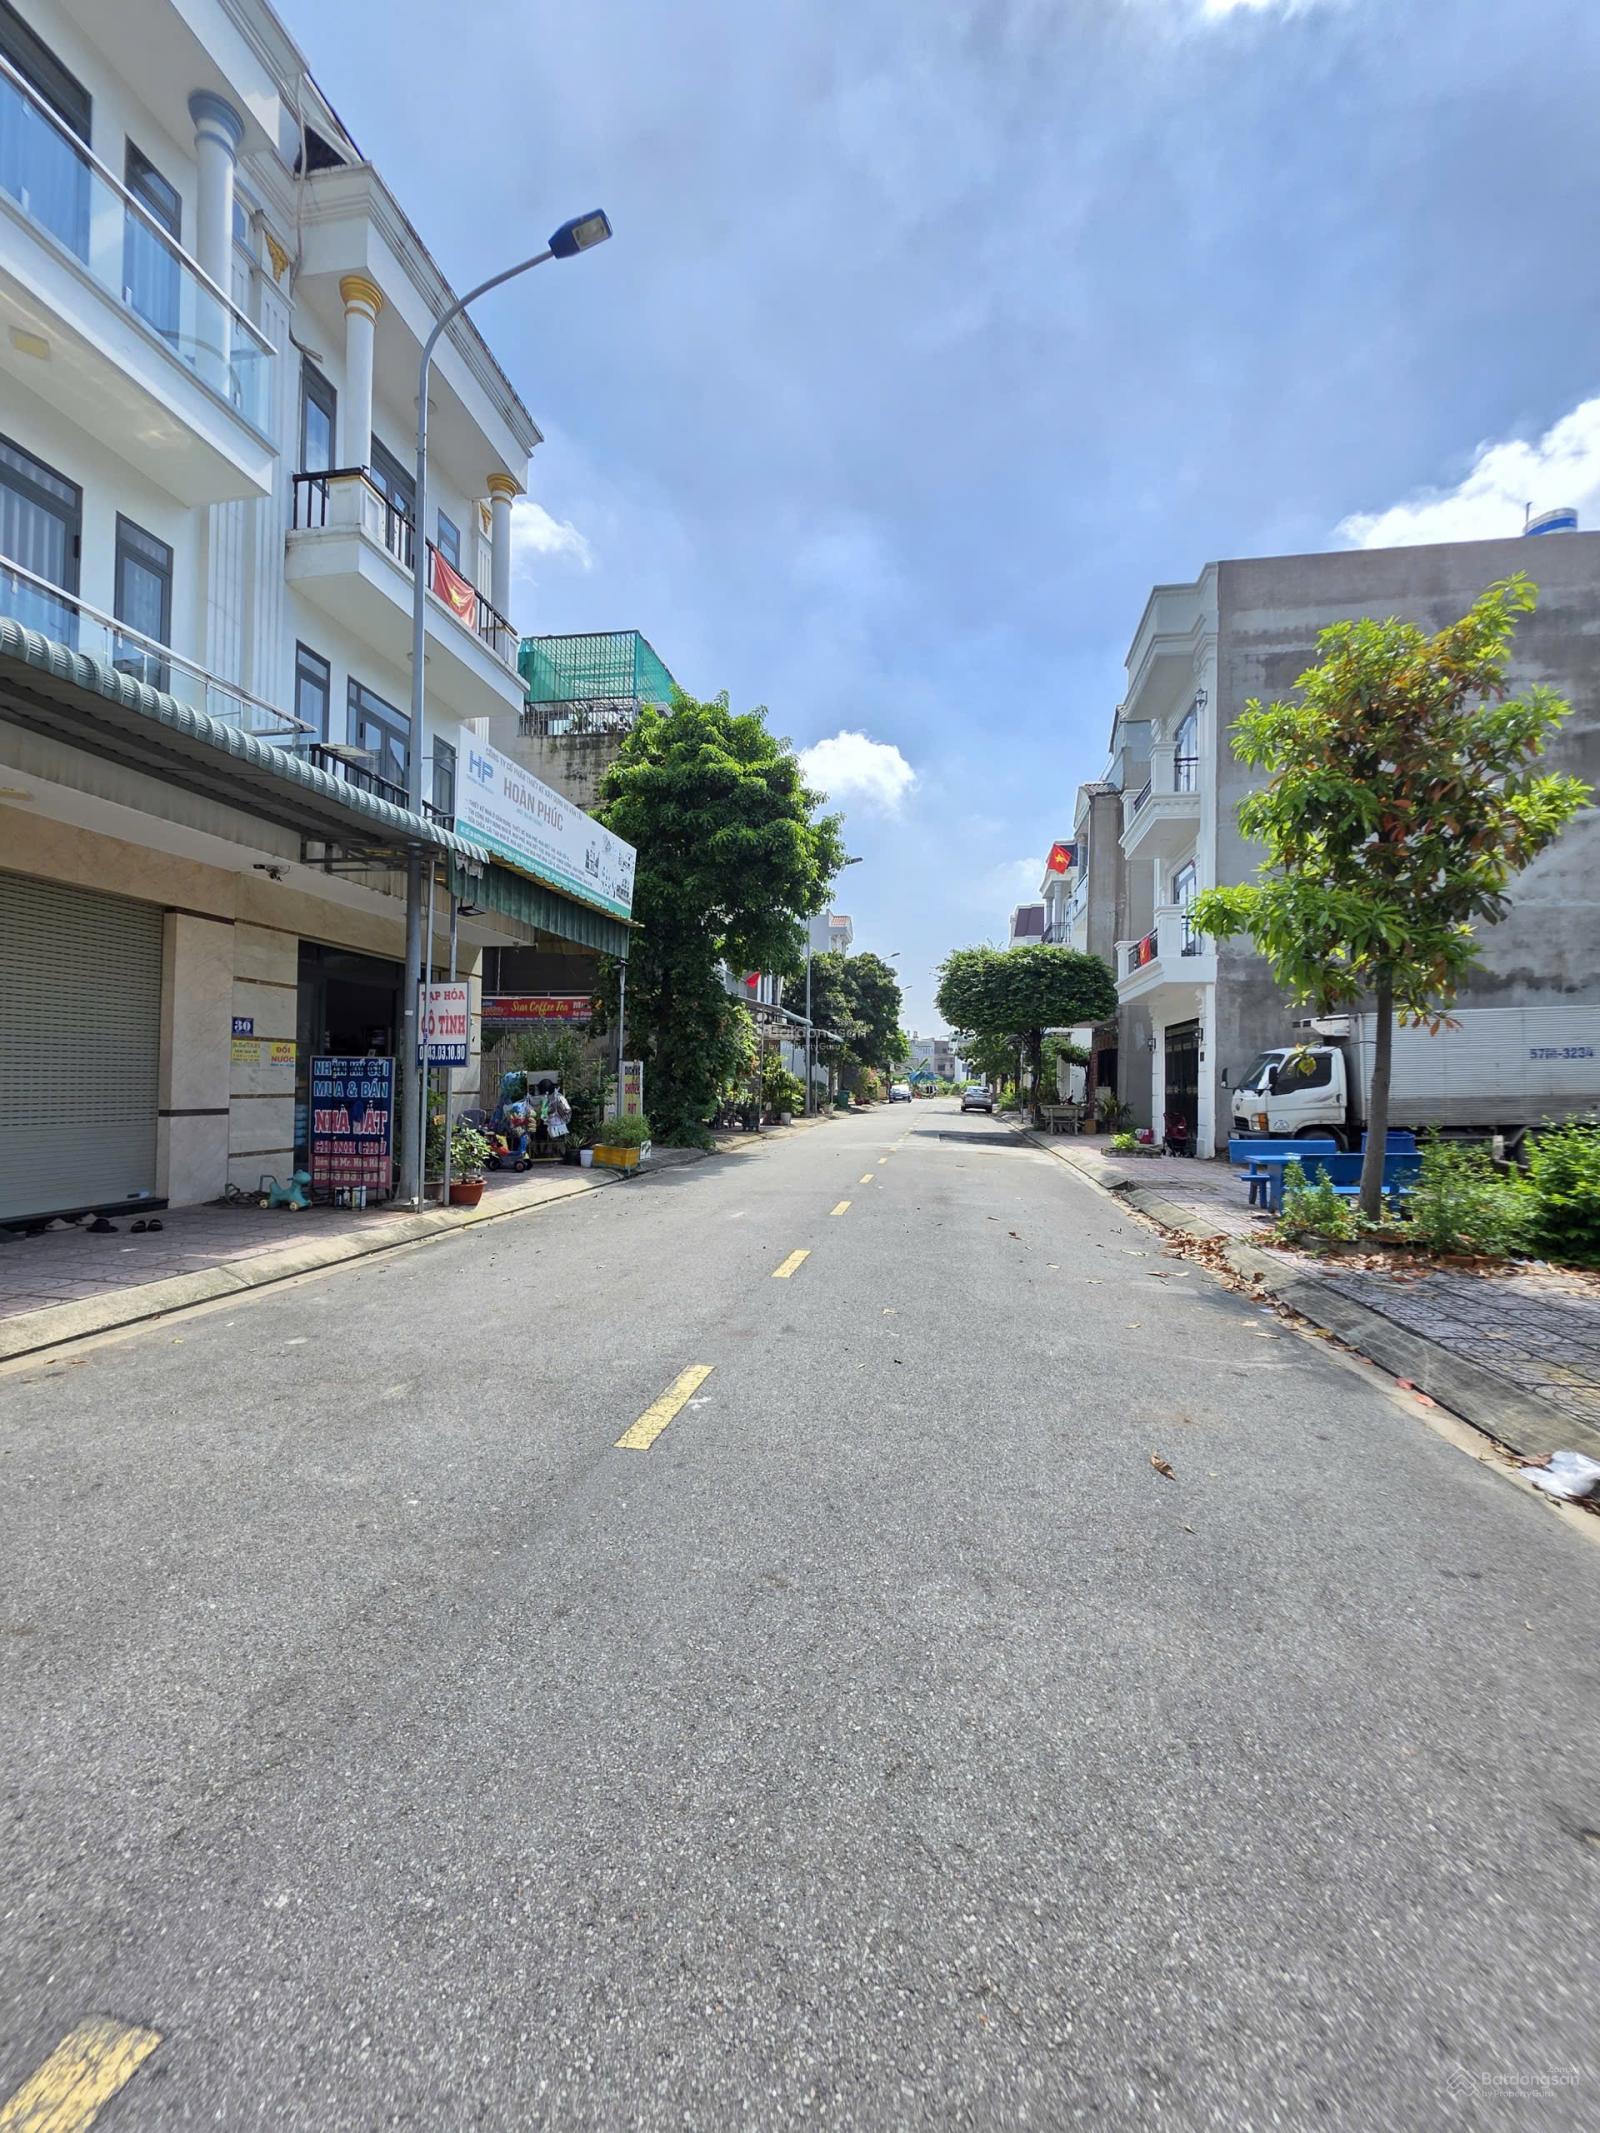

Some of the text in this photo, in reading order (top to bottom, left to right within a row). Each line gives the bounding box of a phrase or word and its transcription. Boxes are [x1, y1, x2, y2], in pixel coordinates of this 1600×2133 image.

[469, 749, 494, 783] HP
[504, 777, 535, 814] HOÀN
[537, 800, 564, 831] PHÚC
[444, 988, 465, 1000] HÓA
[529, 1001, 554, 1015] Coffee
[555, 1002, 569, 1012] Tea
[438, 1009, 466, 1035] TÌNH
[419, 1045, 465, 1060] 043.03.10.80
[314, 1058, 347, 1078] NHẬN
[313, 1078, 388, 1098] MUA & BÁN
[314, 1100, 388, 1135] NHÀ ẤT
[314, 1136, 356, 1154] CHÍNH
[340, 1157, 351, 1167] Mr.
